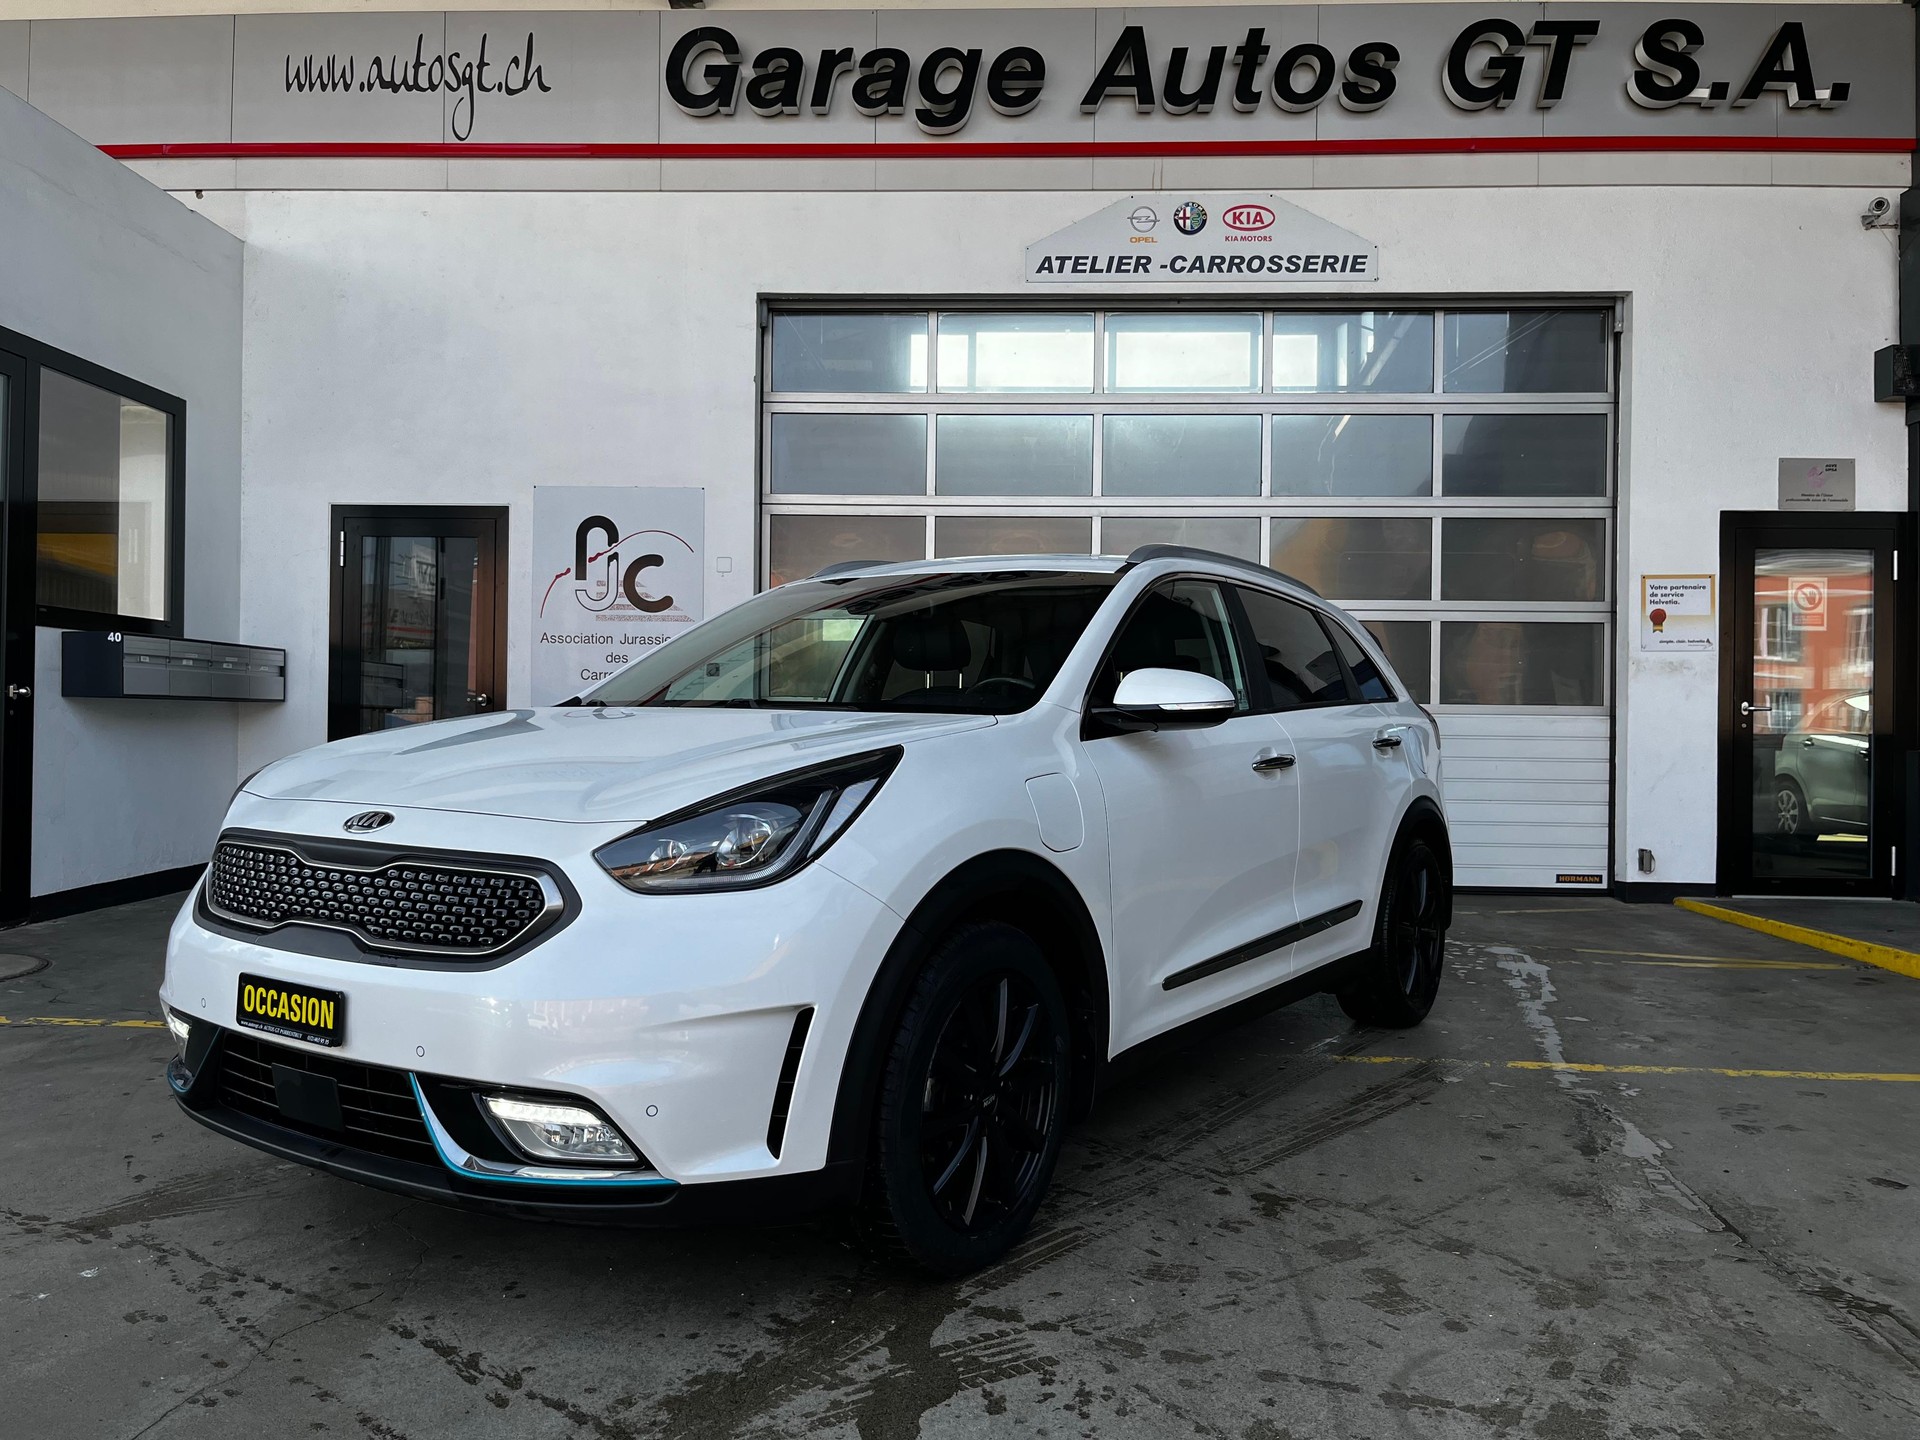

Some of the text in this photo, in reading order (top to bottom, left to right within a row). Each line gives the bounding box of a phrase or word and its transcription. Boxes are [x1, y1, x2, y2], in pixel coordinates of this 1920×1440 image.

[665, 18, 1851, 135] Garage Autos GT S.A.
[286, 32, 551, 141] www.autosgt.ch
[1232, 211, 1265, 225] KIA
[1129, 236, 1158, 244] OPEL
[1035, 255, 1153, 274] ATELIER
[107, 632, 122, 643] 40
[540, 632, 613, 645] Association
[605, 652, 629, 663] des
[243, 984, 334, 1029] OCCASION
